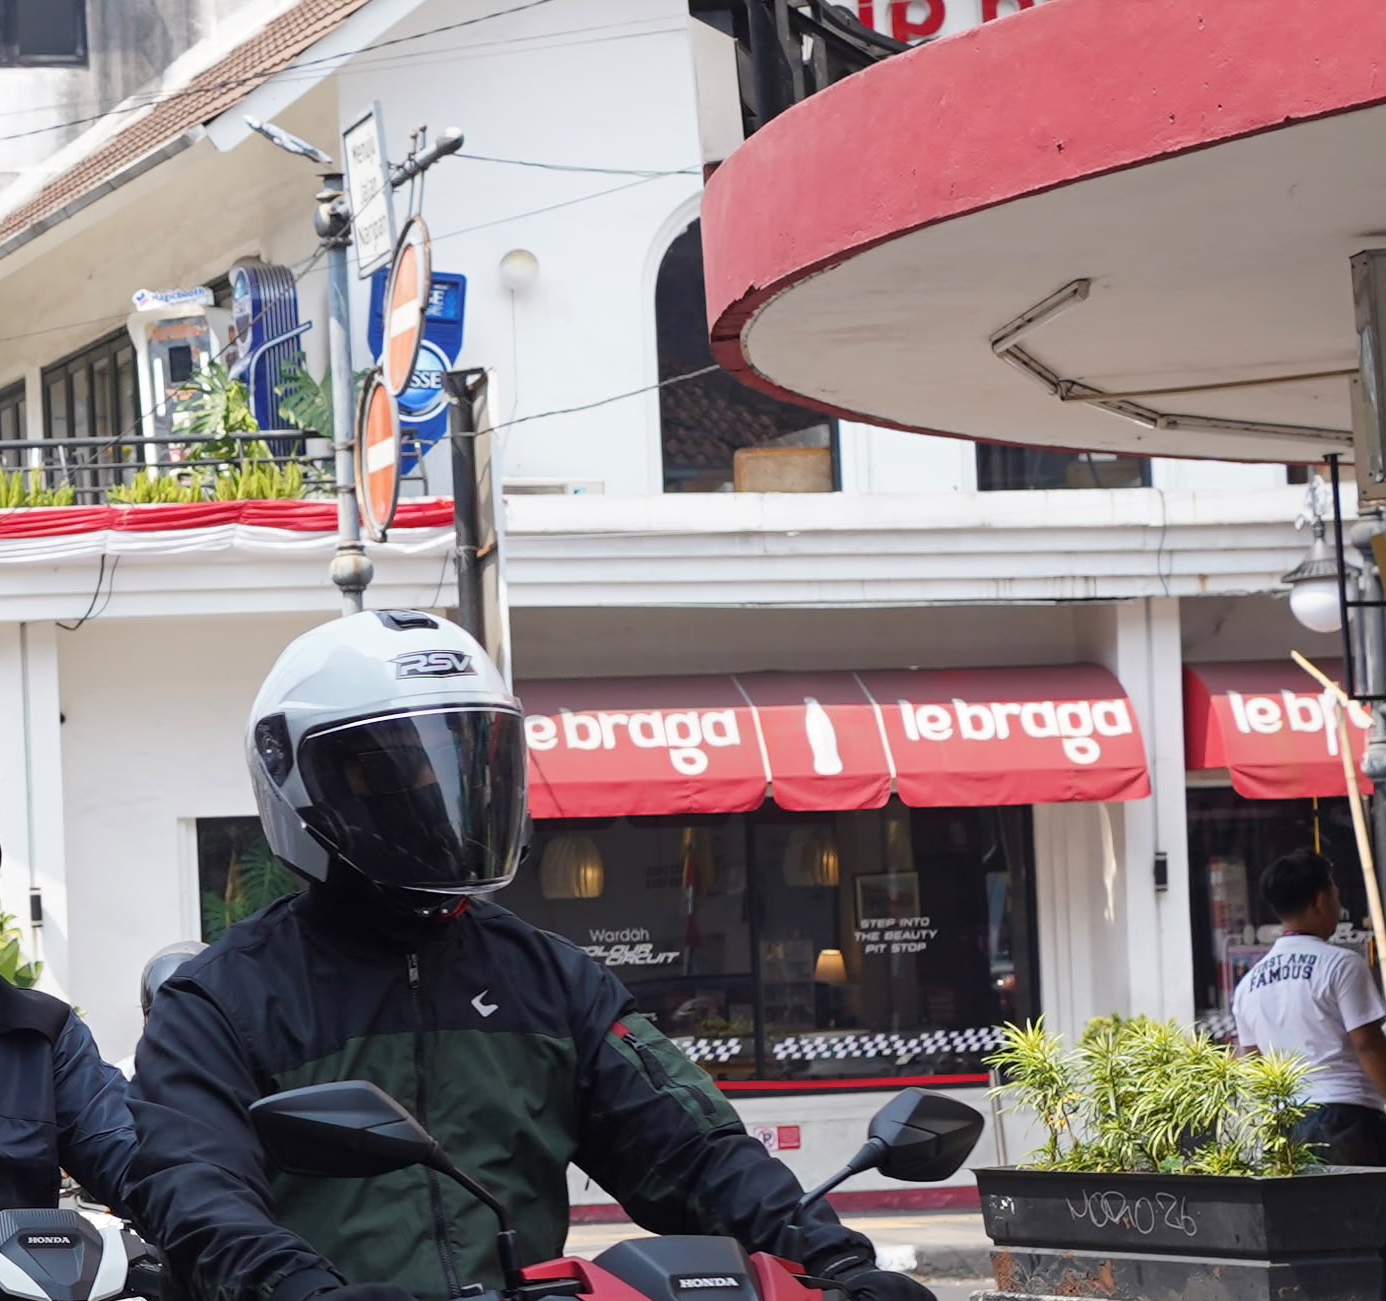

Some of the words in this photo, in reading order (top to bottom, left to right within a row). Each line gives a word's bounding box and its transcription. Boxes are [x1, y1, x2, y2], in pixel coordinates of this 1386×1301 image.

[409, 370, 442, 389] SSE
[388, 653, 470, 675] RSV
[860, 918, 895, 928] STEP
[899, 917, 930, 927] INTO
[589, 928, 650, 942] Wardah
[854, 931, 881, 941] THE
[884, 929, 938, 940] BEAUTY
[580, 943, 653, 957] OLOUR
[865, 943, 887, 954] PIT
[891, 942, 927, 953] STOP
[1287, 953, 1317, 966] AND
[1249, 965, 1313, 992] FAMOUS
[27, 1236, 71, 1244] HONDA
[679, 1277, 740, 1288] HONDA
